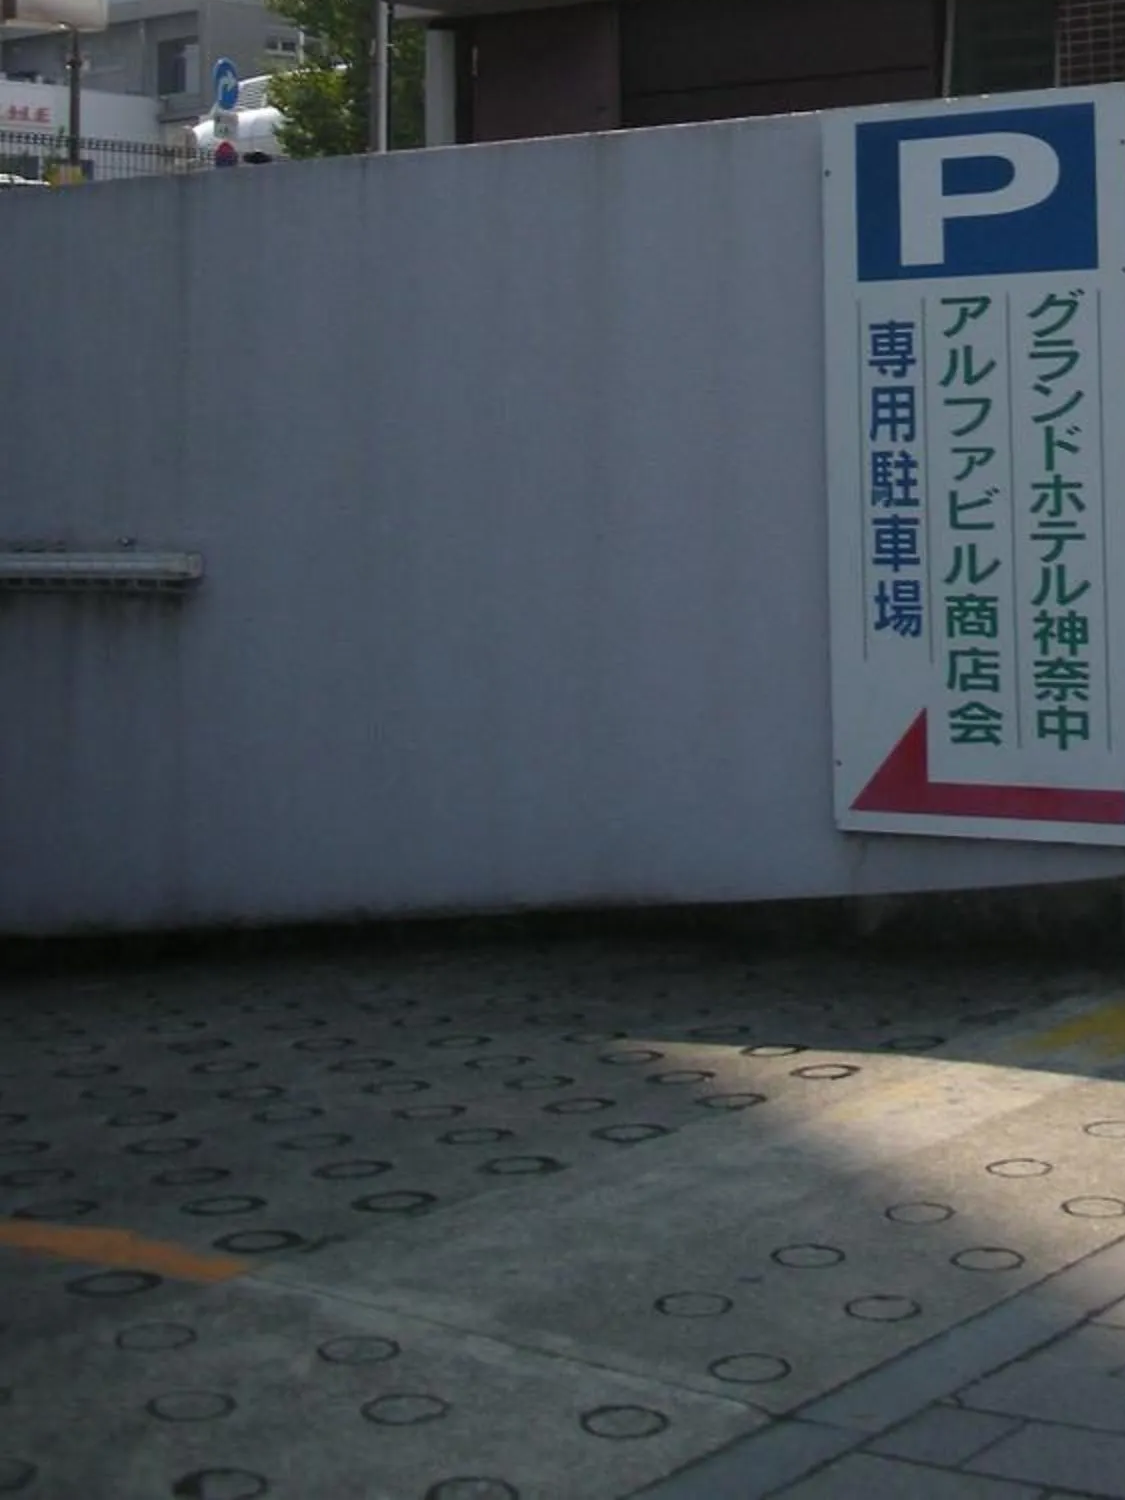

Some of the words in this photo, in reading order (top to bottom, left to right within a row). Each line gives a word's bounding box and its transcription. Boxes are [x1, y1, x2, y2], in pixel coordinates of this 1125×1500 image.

[898, 131, 1060, 267] P
[868, 320, 923, 638] 専用駐車場
[938, 295, 1003, 746] アルファビル商店会
[1027, 289, 1092, 751] グランドホテル神奈中
